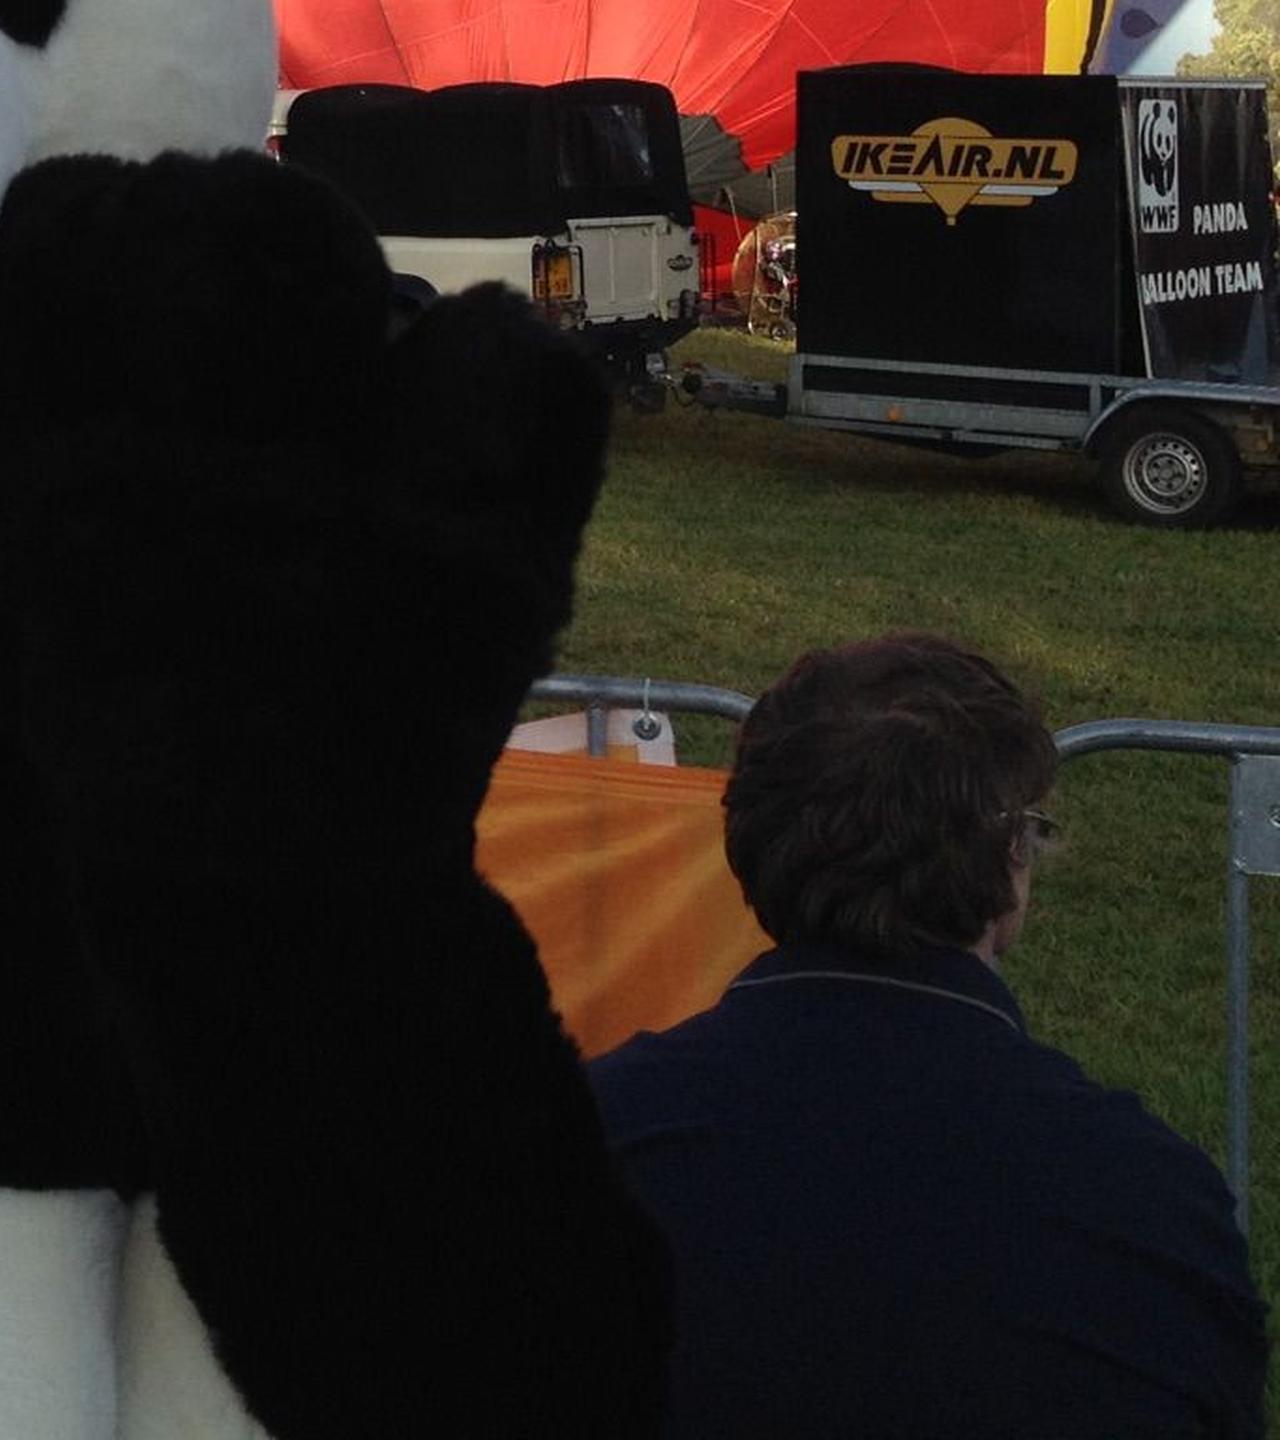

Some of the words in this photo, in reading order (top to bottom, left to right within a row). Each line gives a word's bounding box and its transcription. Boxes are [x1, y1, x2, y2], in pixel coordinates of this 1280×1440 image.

[842, 134, 1065, 180] IKEAIR.NL
[1142, 205, 1176, 229] WWF
[1192, 202, 1248, 235] PANDA
[1214, 261, 1263, 295] TEAM
